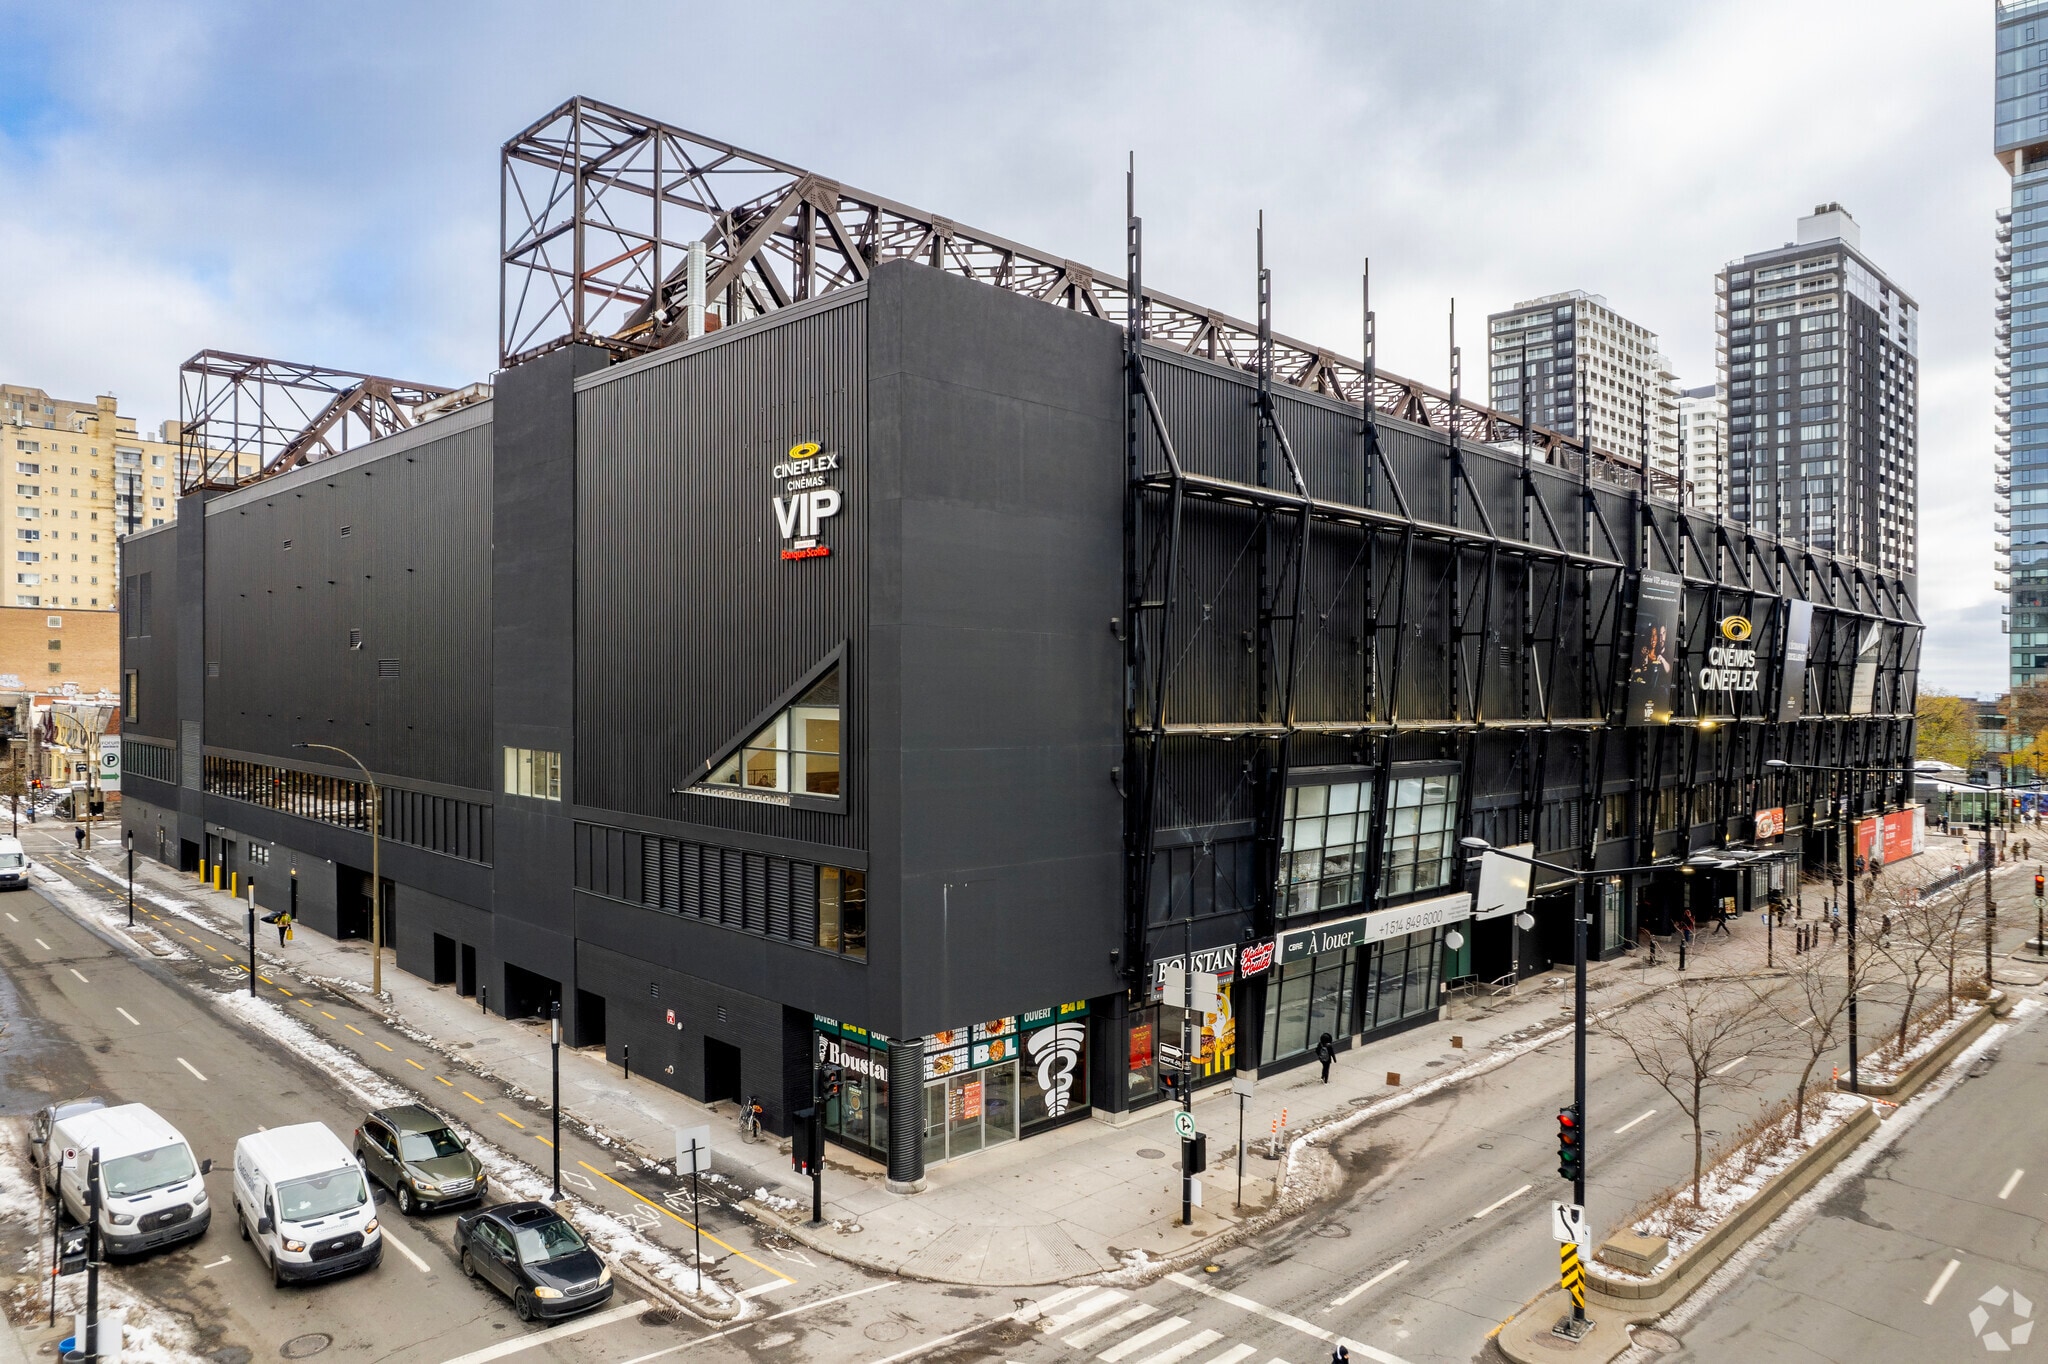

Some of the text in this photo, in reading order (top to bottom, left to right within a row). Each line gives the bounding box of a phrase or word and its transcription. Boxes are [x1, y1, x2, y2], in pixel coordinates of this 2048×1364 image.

[773, 454, 838, 479] CINEPLEX
[787, 475, 824, 491] CINÉMAS
[773, 489, 841, 539] VIP
[781, 545, 829, 561] Banque Scotia
[1709, 644, 1756, 668] CINÉMAS
[1699, 668, 1759, 691] CINEPLEX
[1288, 942, 1303, 952] CBRE
[1307, 931, 1318, 955] À
[1322, 930, 1354, 952] louer
[1406, 915, 1421, 931] 849
[1423, 910, 1443, 926] 6000
[1241, 941, 1275, 962] Madame
[1241, 955, 1271, 978] Poulet
[1024, 1000, 1086, 1023] OUVERT 24 H
